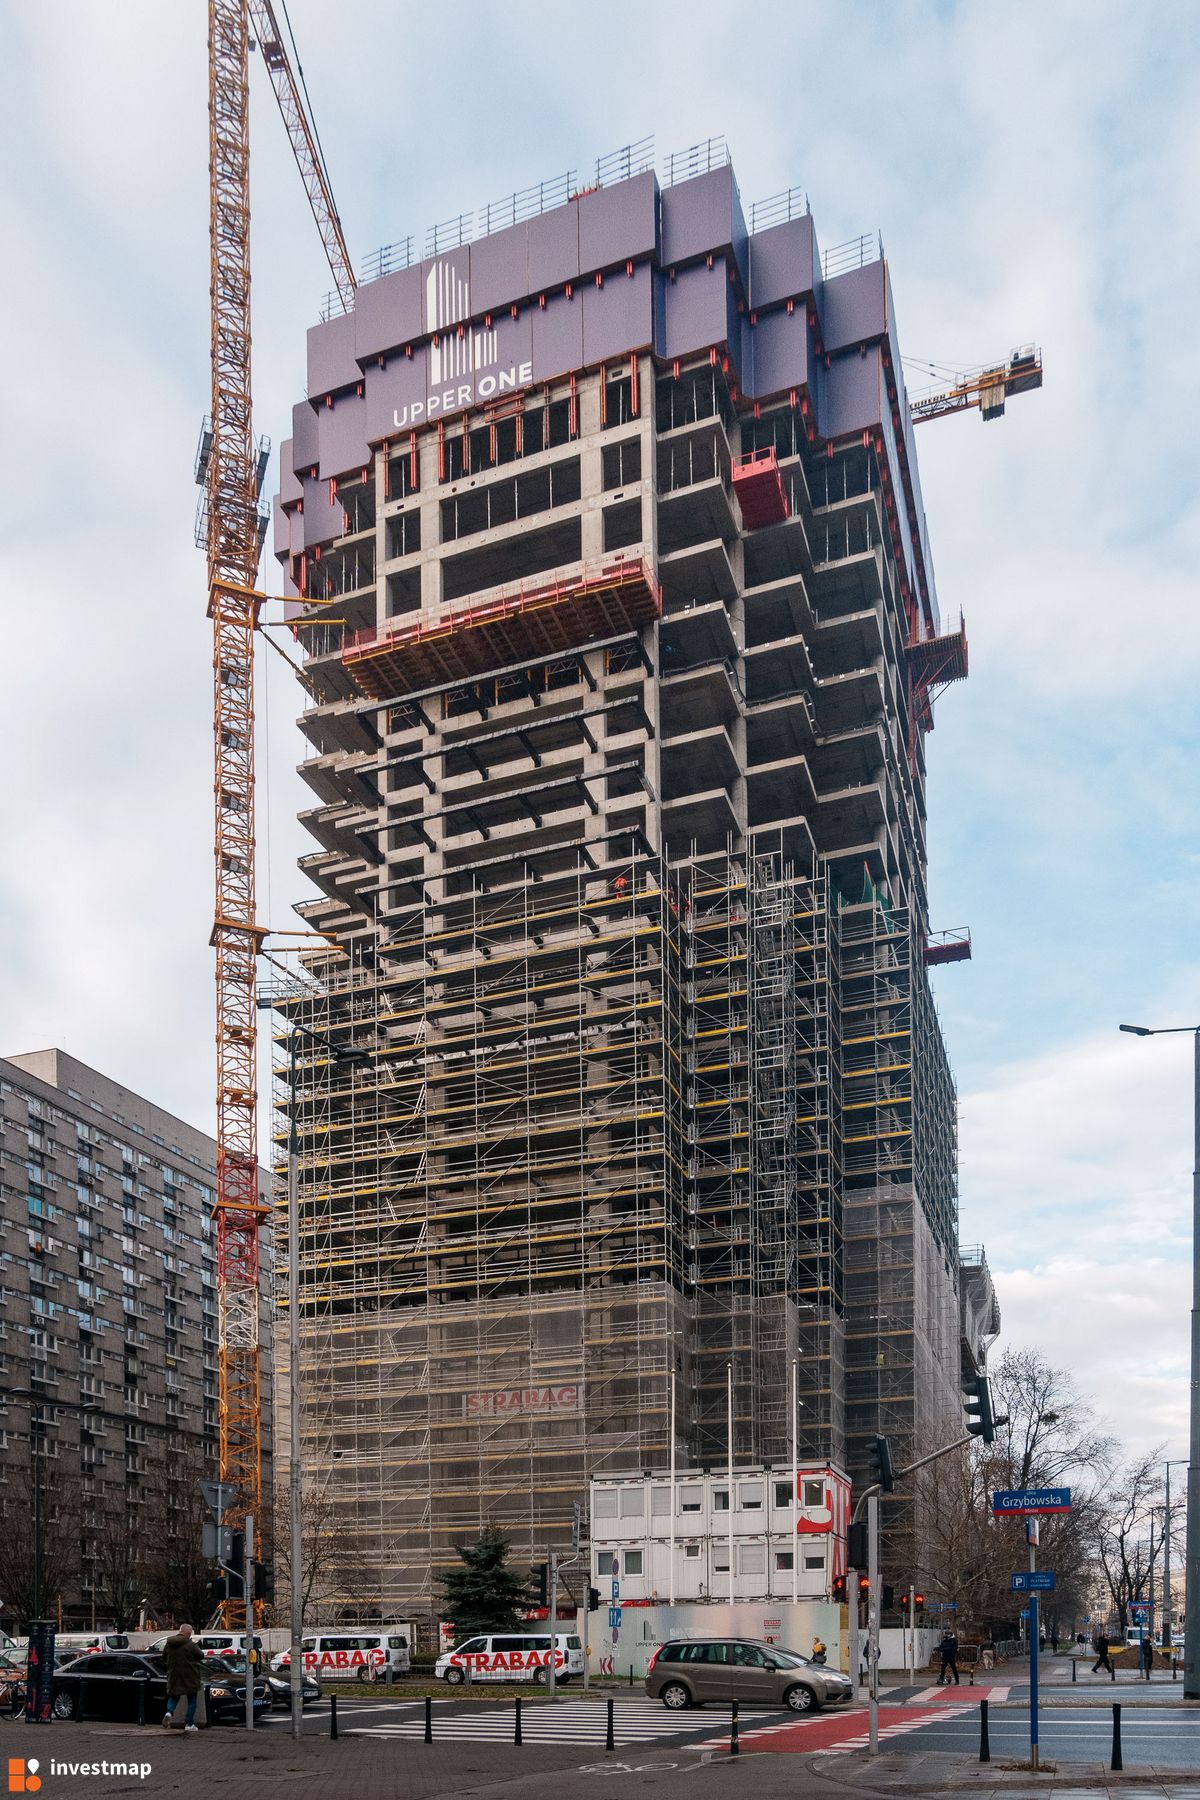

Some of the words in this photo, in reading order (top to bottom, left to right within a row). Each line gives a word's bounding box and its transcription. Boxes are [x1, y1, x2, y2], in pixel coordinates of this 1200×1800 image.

[393, 385, 472, 427] UPPER
[478, 361, 533, 396] ONE
[467, 1387, 576, 1413] STRABAG
[1002, 1494, 1062, 1508] Grzybowska
[1015, 1577, 1023, 1586] P
[281, 1649, 385, 1670] SRABAG
[450, 1650, 564, 1672] STRABAG
